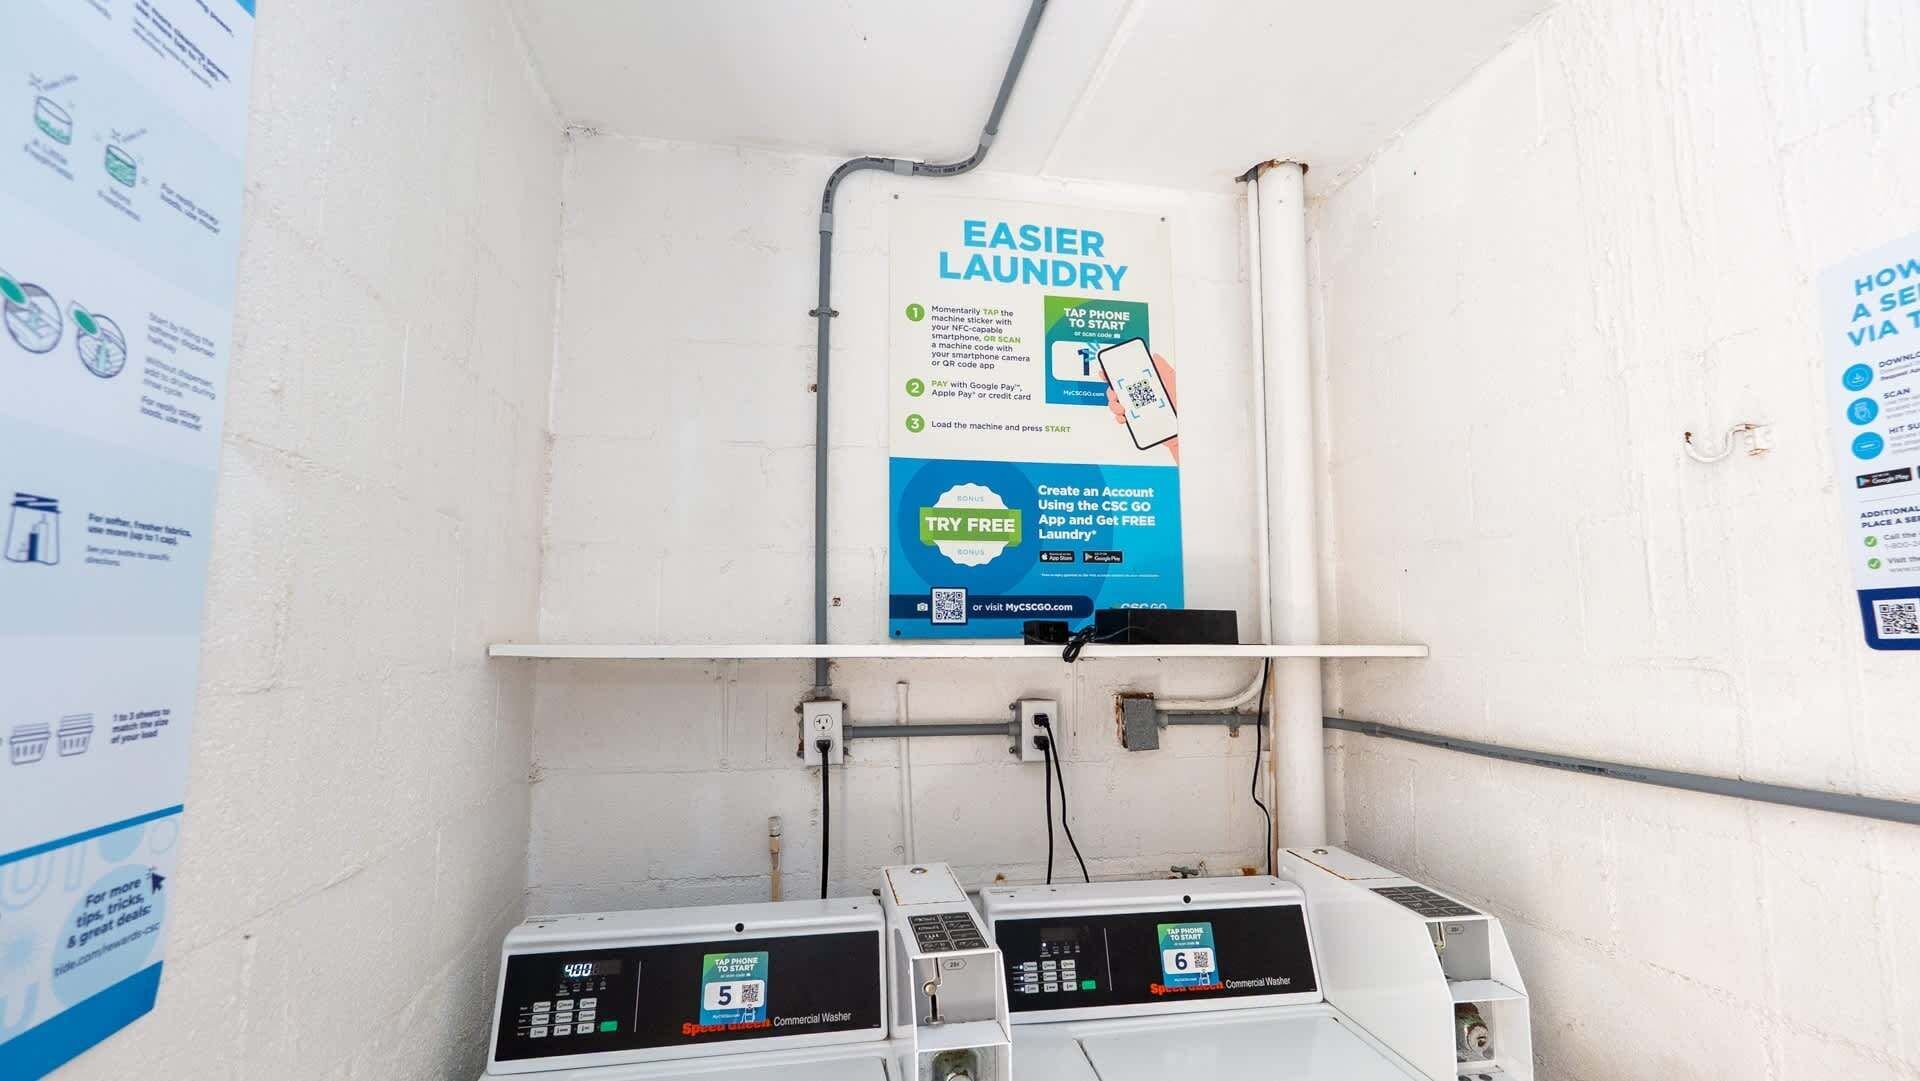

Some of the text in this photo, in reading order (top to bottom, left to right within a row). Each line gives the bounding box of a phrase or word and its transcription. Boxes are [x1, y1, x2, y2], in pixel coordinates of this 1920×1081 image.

[963, 219, 1105, 258] EASIER
[939, 251, 1129, 292] LAUNDRY
[1851, 283, 1920, 323] A SE
[931, 305, 981, 316] Momentarily
[983, 308, 999, 316] TAP
[1063, 307, 1131, 321] TAP PHONE
[931, 315, 1012, 326] machine sticker with
[1068, 318, 1126, 331] TO START
[931, 323, 1003, 334] your NFC-capable
[1847, 319, 1899, 347] VIA
[931, 333, 982, 343] smartphone,
[998, 336, 1021, 344] SCAN
[938, 342, 972, 350] machine
[931, 351, 949, 359] your
[951, 351, 1000, 361] smartphone
[1077, 348, 1090, 376] 1
[931, 379, 949, 388] PAY
[950, 380, 968, 389] with
[969, 381, 998, 391] Google
[931, 389, 956, 398] Apple
[988, 391, 1012, 400] credit
[1013, 392, 1031, 401] card
[1883, 387, 1911, 400] SCAN
[931, 420, 952, 428] Load
[954, 421, 967, 429] the
[969, 421, 1003, 431] machine
[1005, 423, 1020, 431] and
[1022, 425, 1043, 433] press
[1044, 425, 1071, 433] START
[1888, 425, 1905, 434] HIT
[1038, 484, 1154, 498] Create an Account
[1038, 499, 1151, 513] Using the CSC GO
[1861, 505, 1920, 519] ADDITIONAL
[88, 512, 104, 523] For
[1038, 514, 1156, 527] App and Get FREE
[1861, 518, 1893, 529] PLACE
[925, 516, 1016, 533] TRY FREE
[87, 526, 104, 535] use
[105, 528, 129, 537] more
[957, 548, 985, 556] BONUS
[985, 602, 1003, 611] visit
[1005, 602, 1073, 613] MyCSCGO.com
[85, 878, 142, 908] For more
[76, 893, 145, 930] tips, tricks,
[66, 935, 77, 949] &
[79, 919, 114, 947] great
[1180, 933, 1202, 941] START
[715, 957, 759, 966] TAP PHONE
[1175, 952, 1188, 971] 6
[717, 964, 755, 973] TO START
[1225, 976, 1291, 989] Commercial Washer
[718, 985, 732, 1006] 5
[774, 1013, 821, 1027] Commercial
[822, 1011, 852, 1023] Washer
